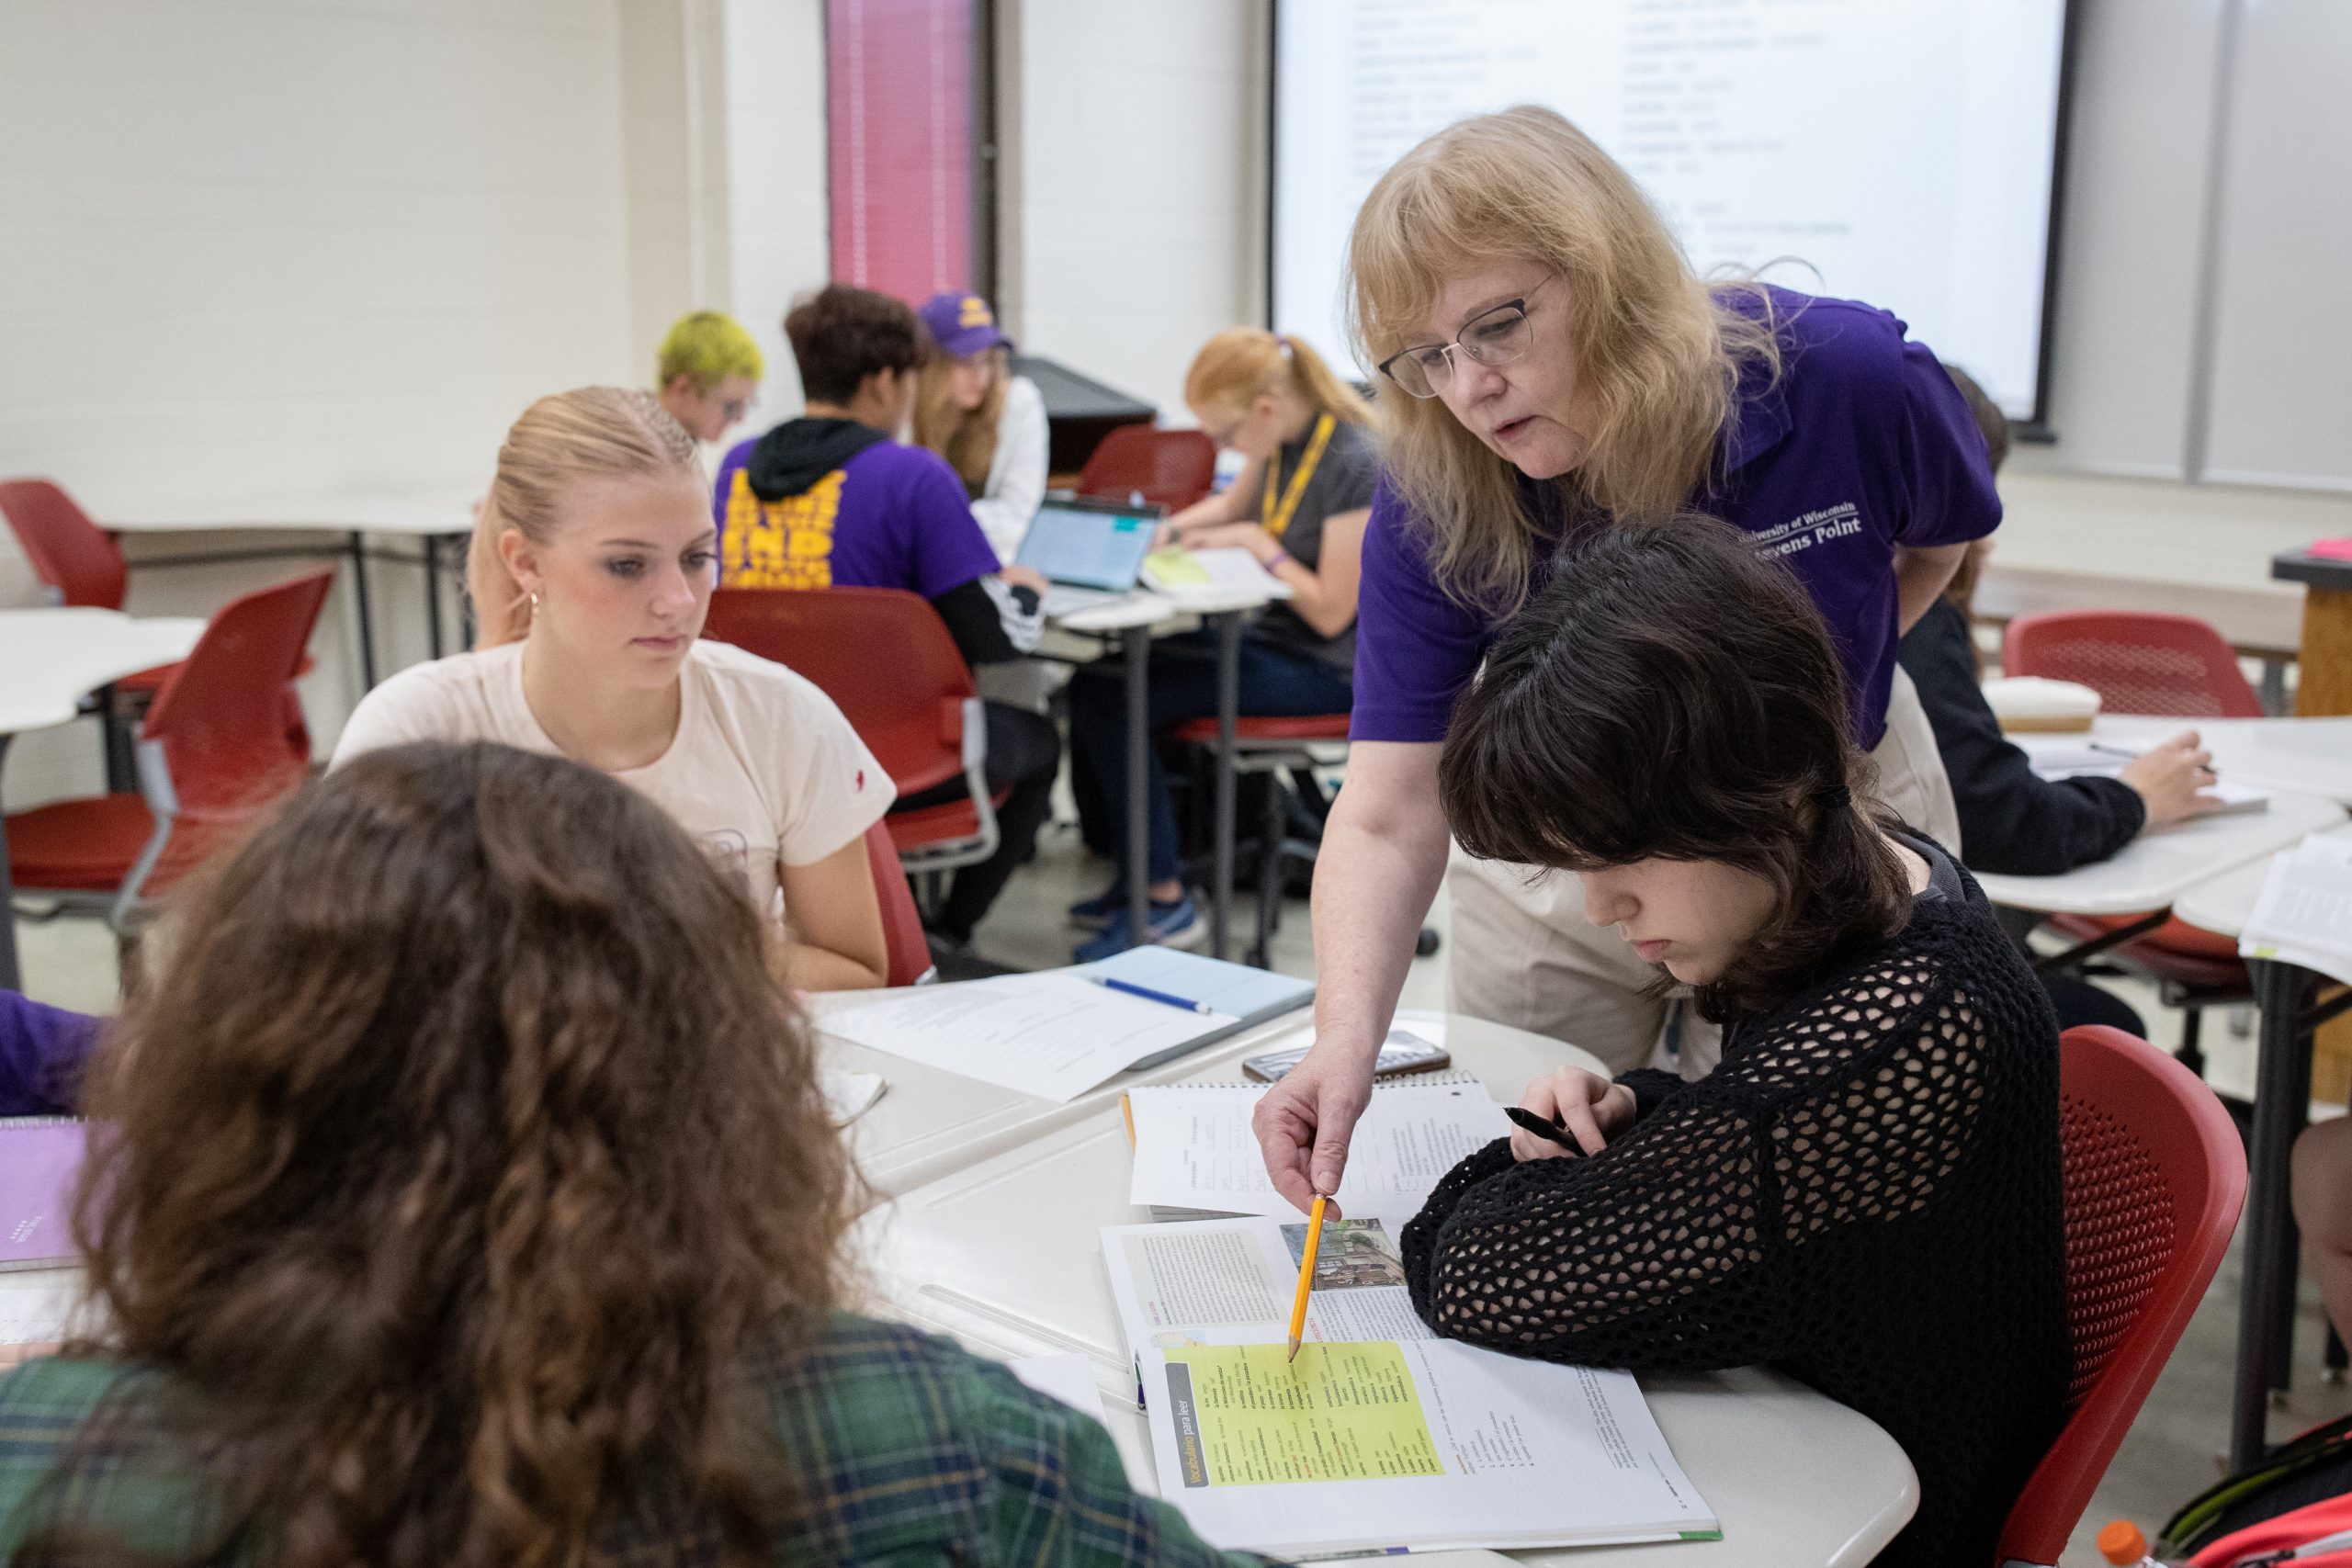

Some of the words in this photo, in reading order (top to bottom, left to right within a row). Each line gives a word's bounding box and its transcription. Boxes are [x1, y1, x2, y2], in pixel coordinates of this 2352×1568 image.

[1738, 523, 1790, 543] niversity
[1791, 516, 1802, 530] of
[1803, 501, 1857, 525] Wisconsin
[1815, 517, 1862, 545] Point
[1178, 1400, 1190, 1416] leer
[1182, 1417, 1195, 1436] para
[1185, 1436, 1202, 1484] Vocabulario
